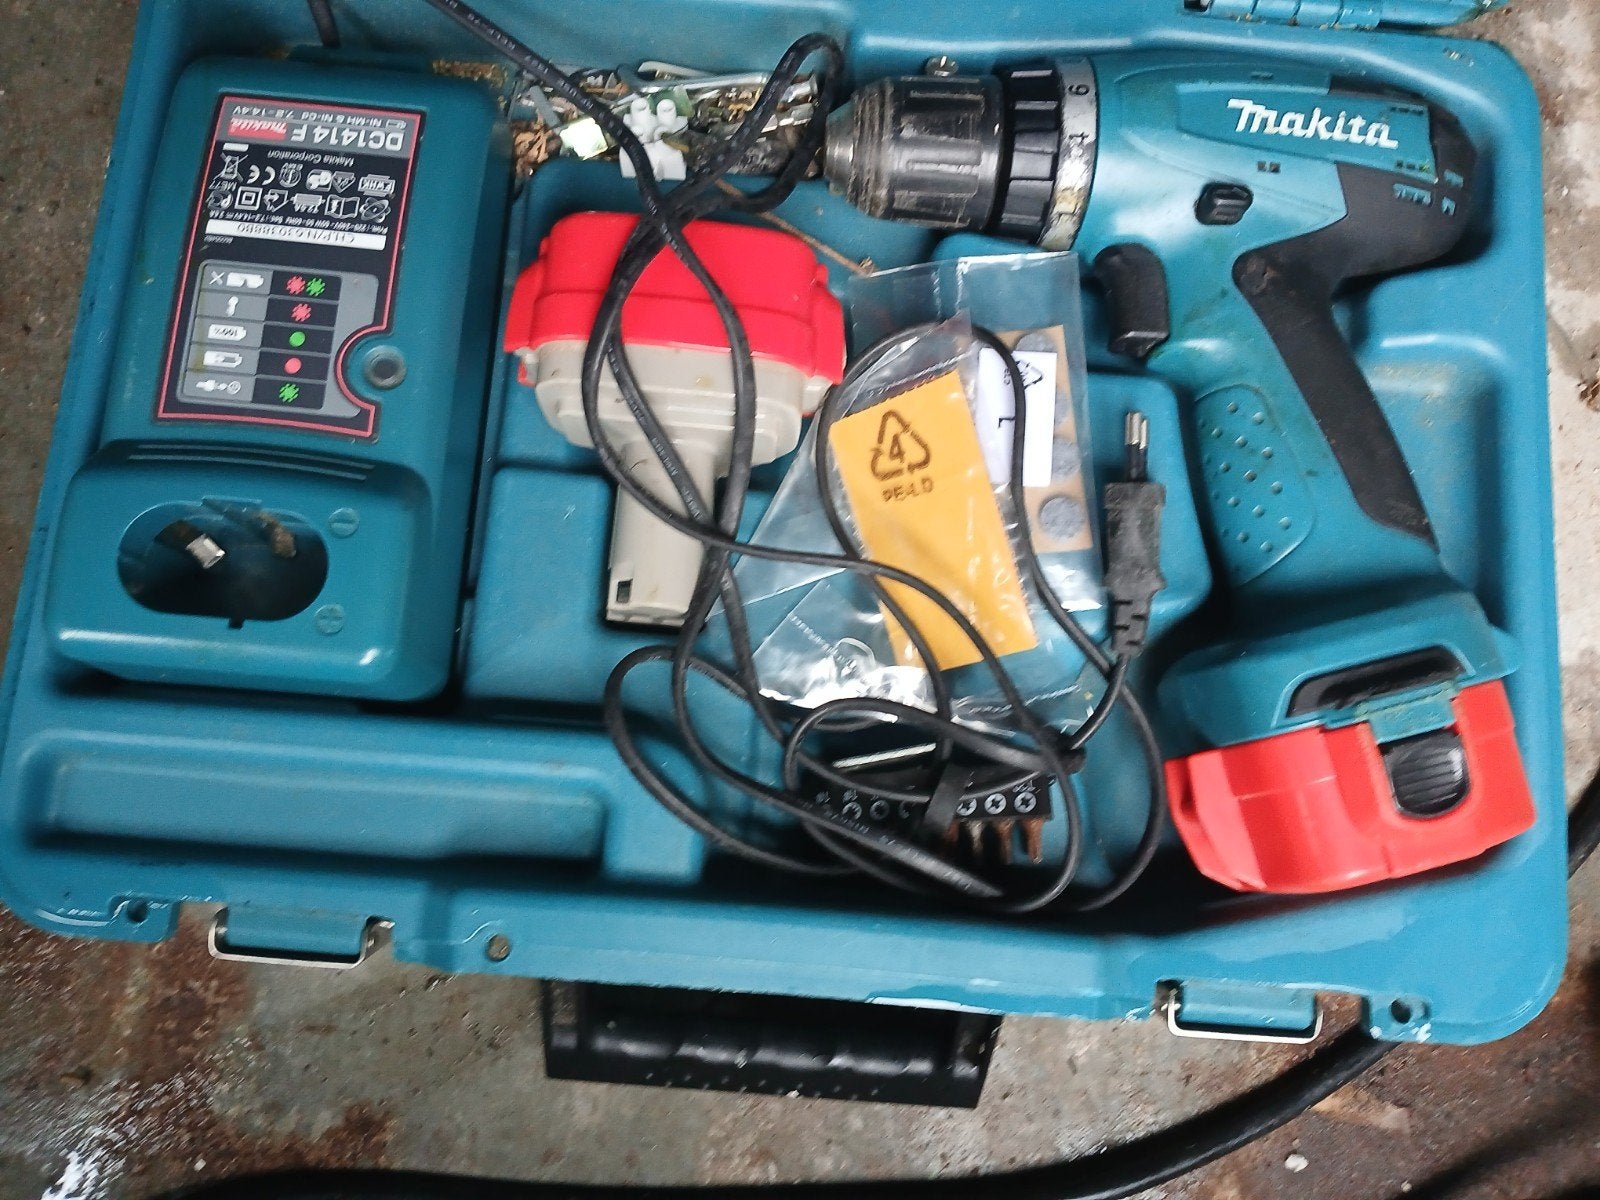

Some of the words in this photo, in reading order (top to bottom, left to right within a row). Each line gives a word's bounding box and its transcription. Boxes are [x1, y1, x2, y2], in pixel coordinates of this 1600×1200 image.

[291, 127, 307, 142] F
[313, 125, 404, 151] DC1414
[268, 149, 322, 164] Corporation
[323, 155, 355, 167] Makita
[888, 434, 905, 463] 4
